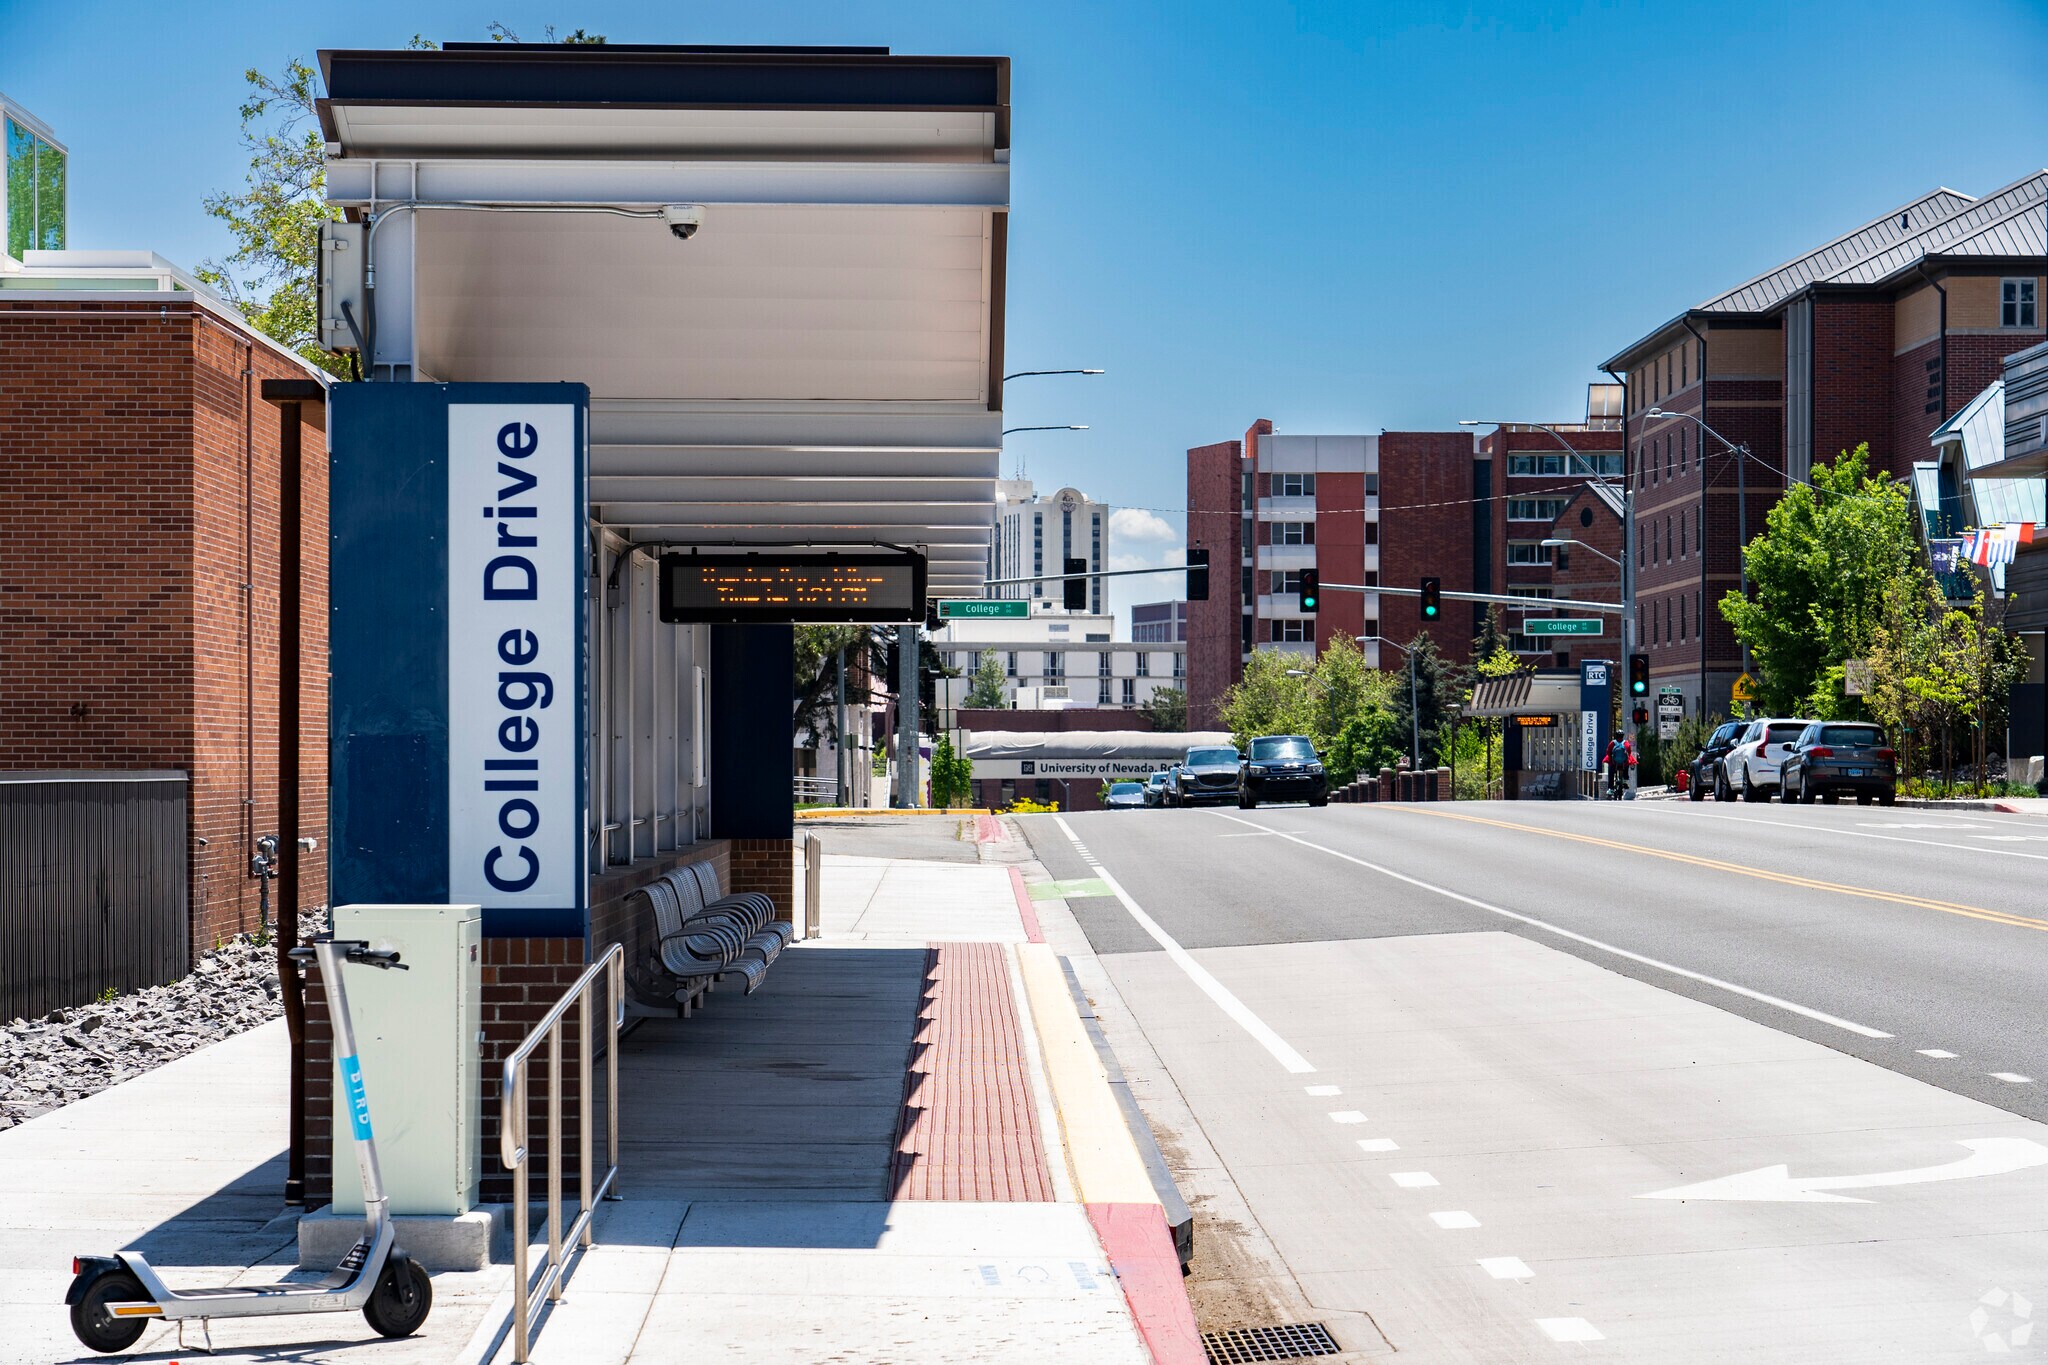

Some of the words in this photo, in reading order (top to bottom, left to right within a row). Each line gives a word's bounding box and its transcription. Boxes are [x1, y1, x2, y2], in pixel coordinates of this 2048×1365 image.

[484, 422, 538, 600] Drive
[965, 604, 1000, 614] College
[1547, 622, 1577, 632] College
[1588, 671, 1605, 679] RTC
[1586, 712, 1594, 735] Drive
[484, 629, 553, 892] College
[1586, 737, 1595, 768] College
[1040, 763, 1096, 775] University
[1098, 763, 1111, 773] of
[351, 1070, 369, 1124] BIRD
